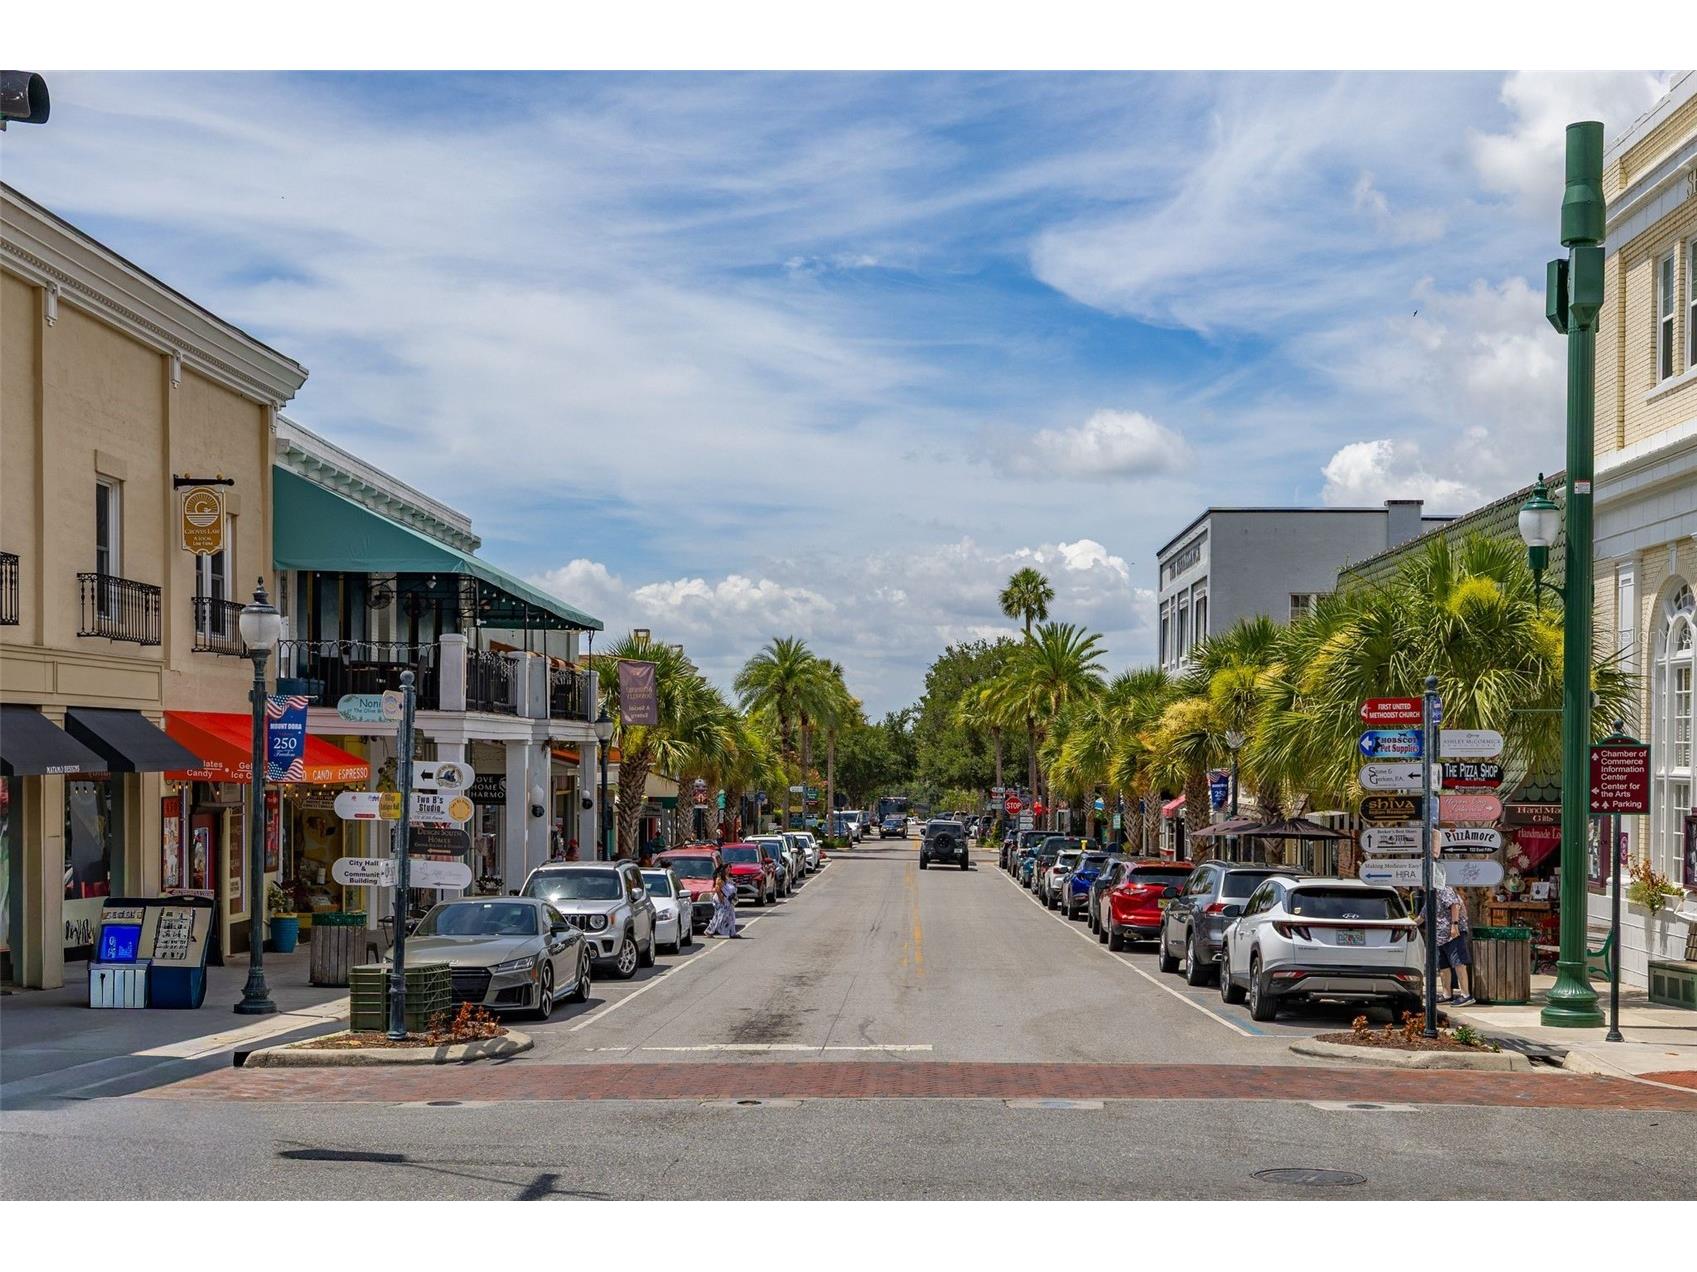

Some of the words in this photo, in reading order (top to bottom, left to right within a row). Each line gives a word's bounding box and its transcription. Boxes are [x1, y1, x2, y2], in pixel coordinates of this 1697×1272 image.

[359, 698, 381, 708] Noni
[1368, 711, 1399, 719] METHODIST
[1398, 711, 1420, 719] CHURCH
[273, 737, 297, 749] 250
[1380, 744, 1392, 752] Pet
[1391, 744, 1420, 754] Supplies
[203, 760, 223, 769] lates
[238, 761, 253, 770] Gel
[1600, 765, 1645, 773] Information
[186, 769, 213, 779] Candy
[231, 771, 243, 779] Ice
[338, 767, 368, 780] ESPRESSO
[1445, 763, 1458, 778] THE
[1459, 763, 1479, 778] PIZZA
[1480, 763, 1499, 778] SHOP
[471, 783, 497, 791] HOME
[1600, 782, 1628, 790] Center
[1629, 782, 1641, 790] for
[470, 791, 505, 799] HARMO
[1600, 790, 1613, 798] the
[1614, 790, 1631, 798] Arts
[416, 795, 430, 804] Two
[432, 795, 444, 804] B's
[418, 803, 441, 812] Studio
[1006, 802, 1021, 810] STOP
[1612, 800, 1643, 809] Parking
[1517, 805, 1543, 814] Hand
[1543, 806, 1562, 814] Ma
[1517, 827, 1551, 839] Handmade
[1552, 827, 1562, 839] Lo
[348, 859, 363, 867] City
[364, 859, 379, 867] Hall
[343, 870, 381, 878] Communit
[349, 877, 378, 885] Building
